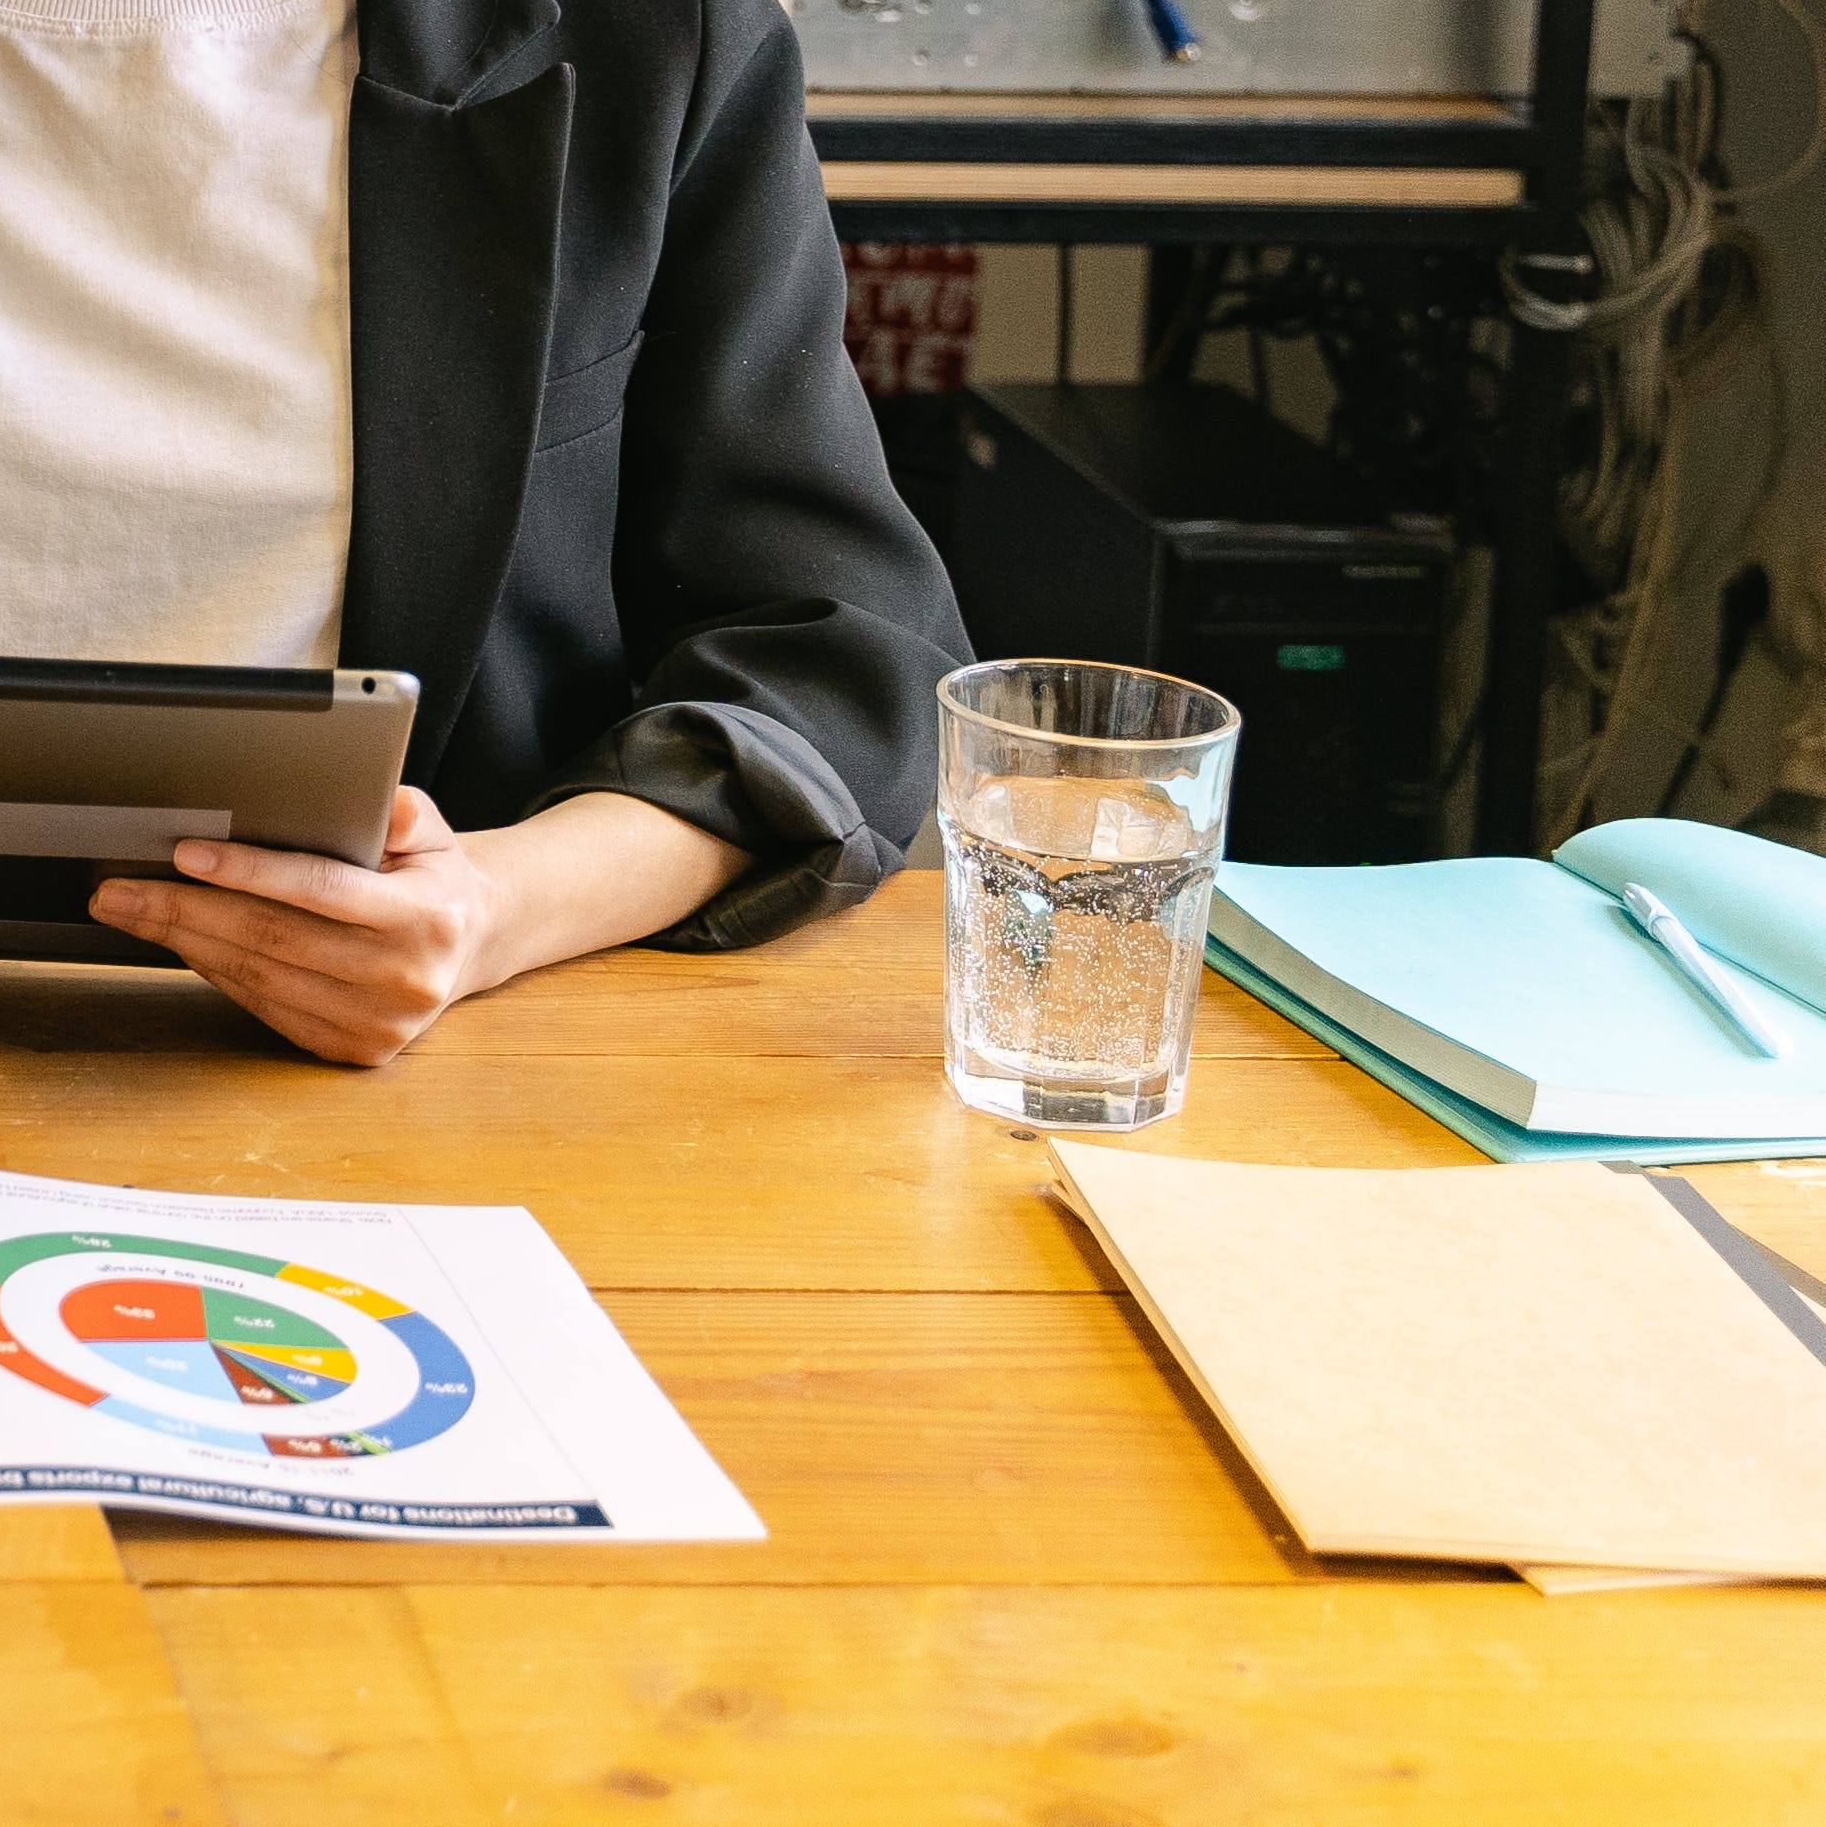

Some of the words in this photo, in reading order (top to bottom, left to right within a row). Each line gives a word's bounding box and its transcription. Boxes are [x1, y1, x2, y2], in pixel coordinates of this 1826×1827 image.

[27, 1470, 135, 1491] exports
[138, 1475, 292, 1510] agricultural
[297, 1496, 355, 1518] U.S.
[359, 1504, 401, 1523] for
[403, 1505, 577, 1524] Destinations
